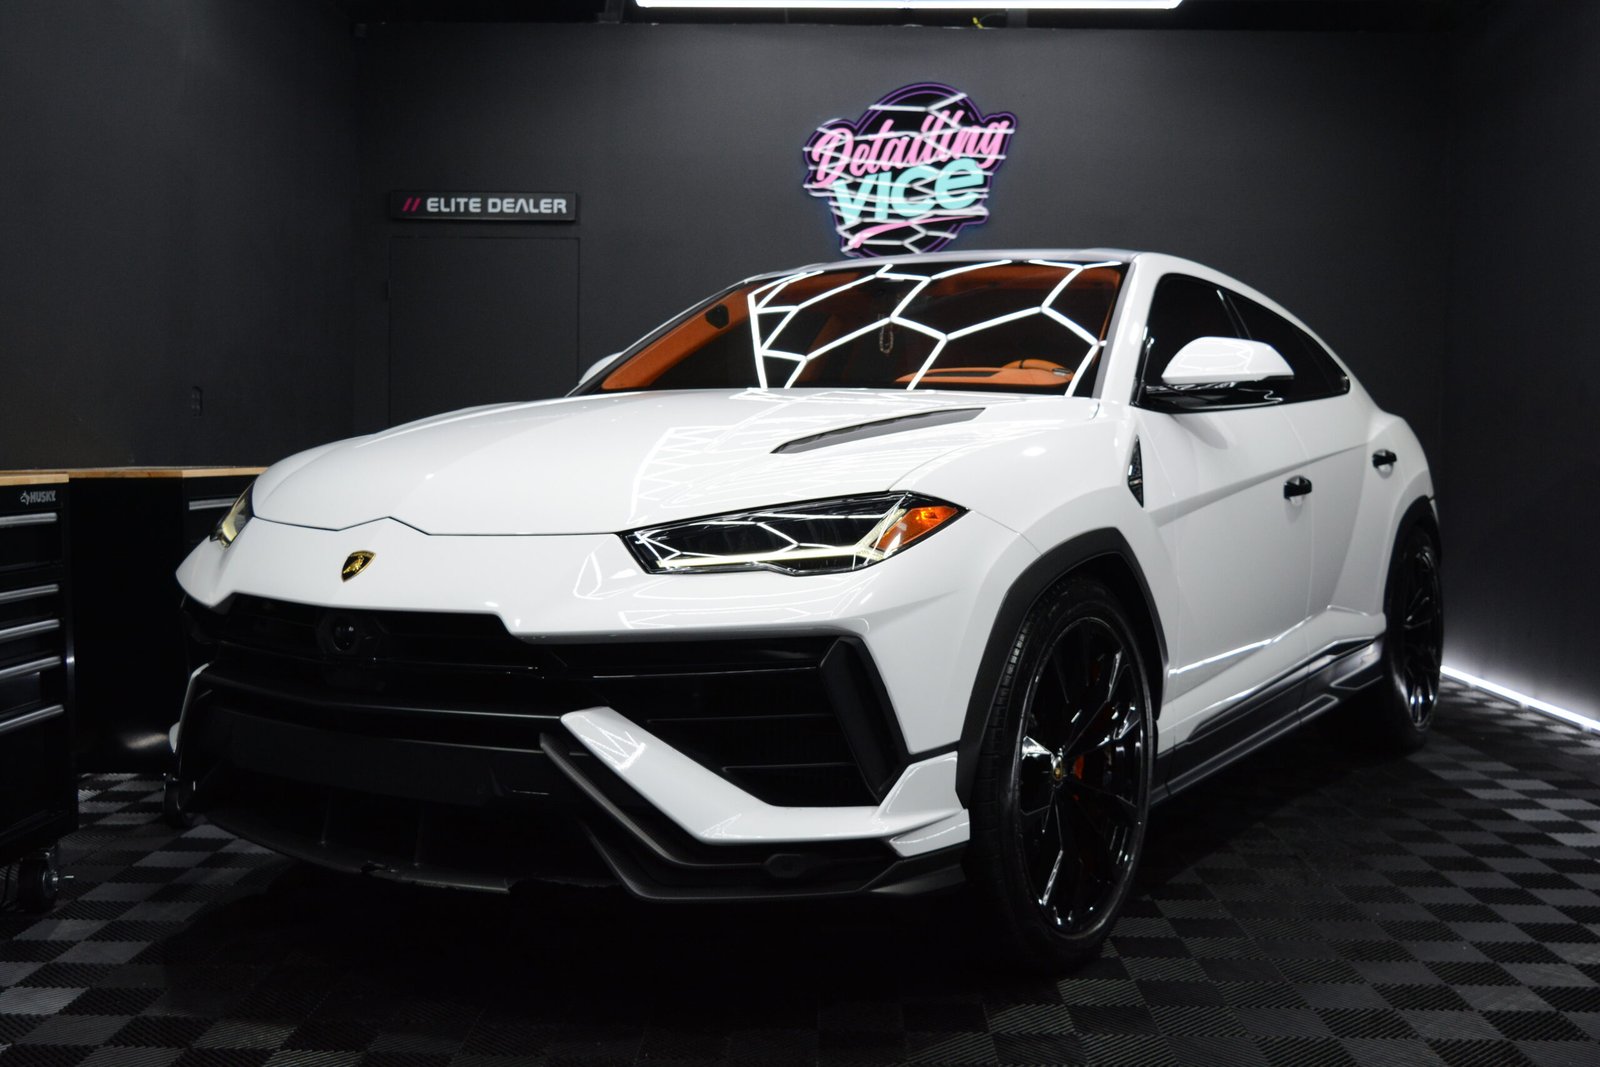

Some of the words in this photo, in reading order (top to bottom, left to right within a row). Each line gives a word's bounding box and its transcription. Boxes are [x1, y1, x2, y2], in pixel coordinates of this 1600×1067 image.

[812, 110, 1010, 188] Detailing
[426, 197, 482, 212] ELITE
[487, 198, 567, 214] DEALER
[30, 490, 56, 503] HUSKY
